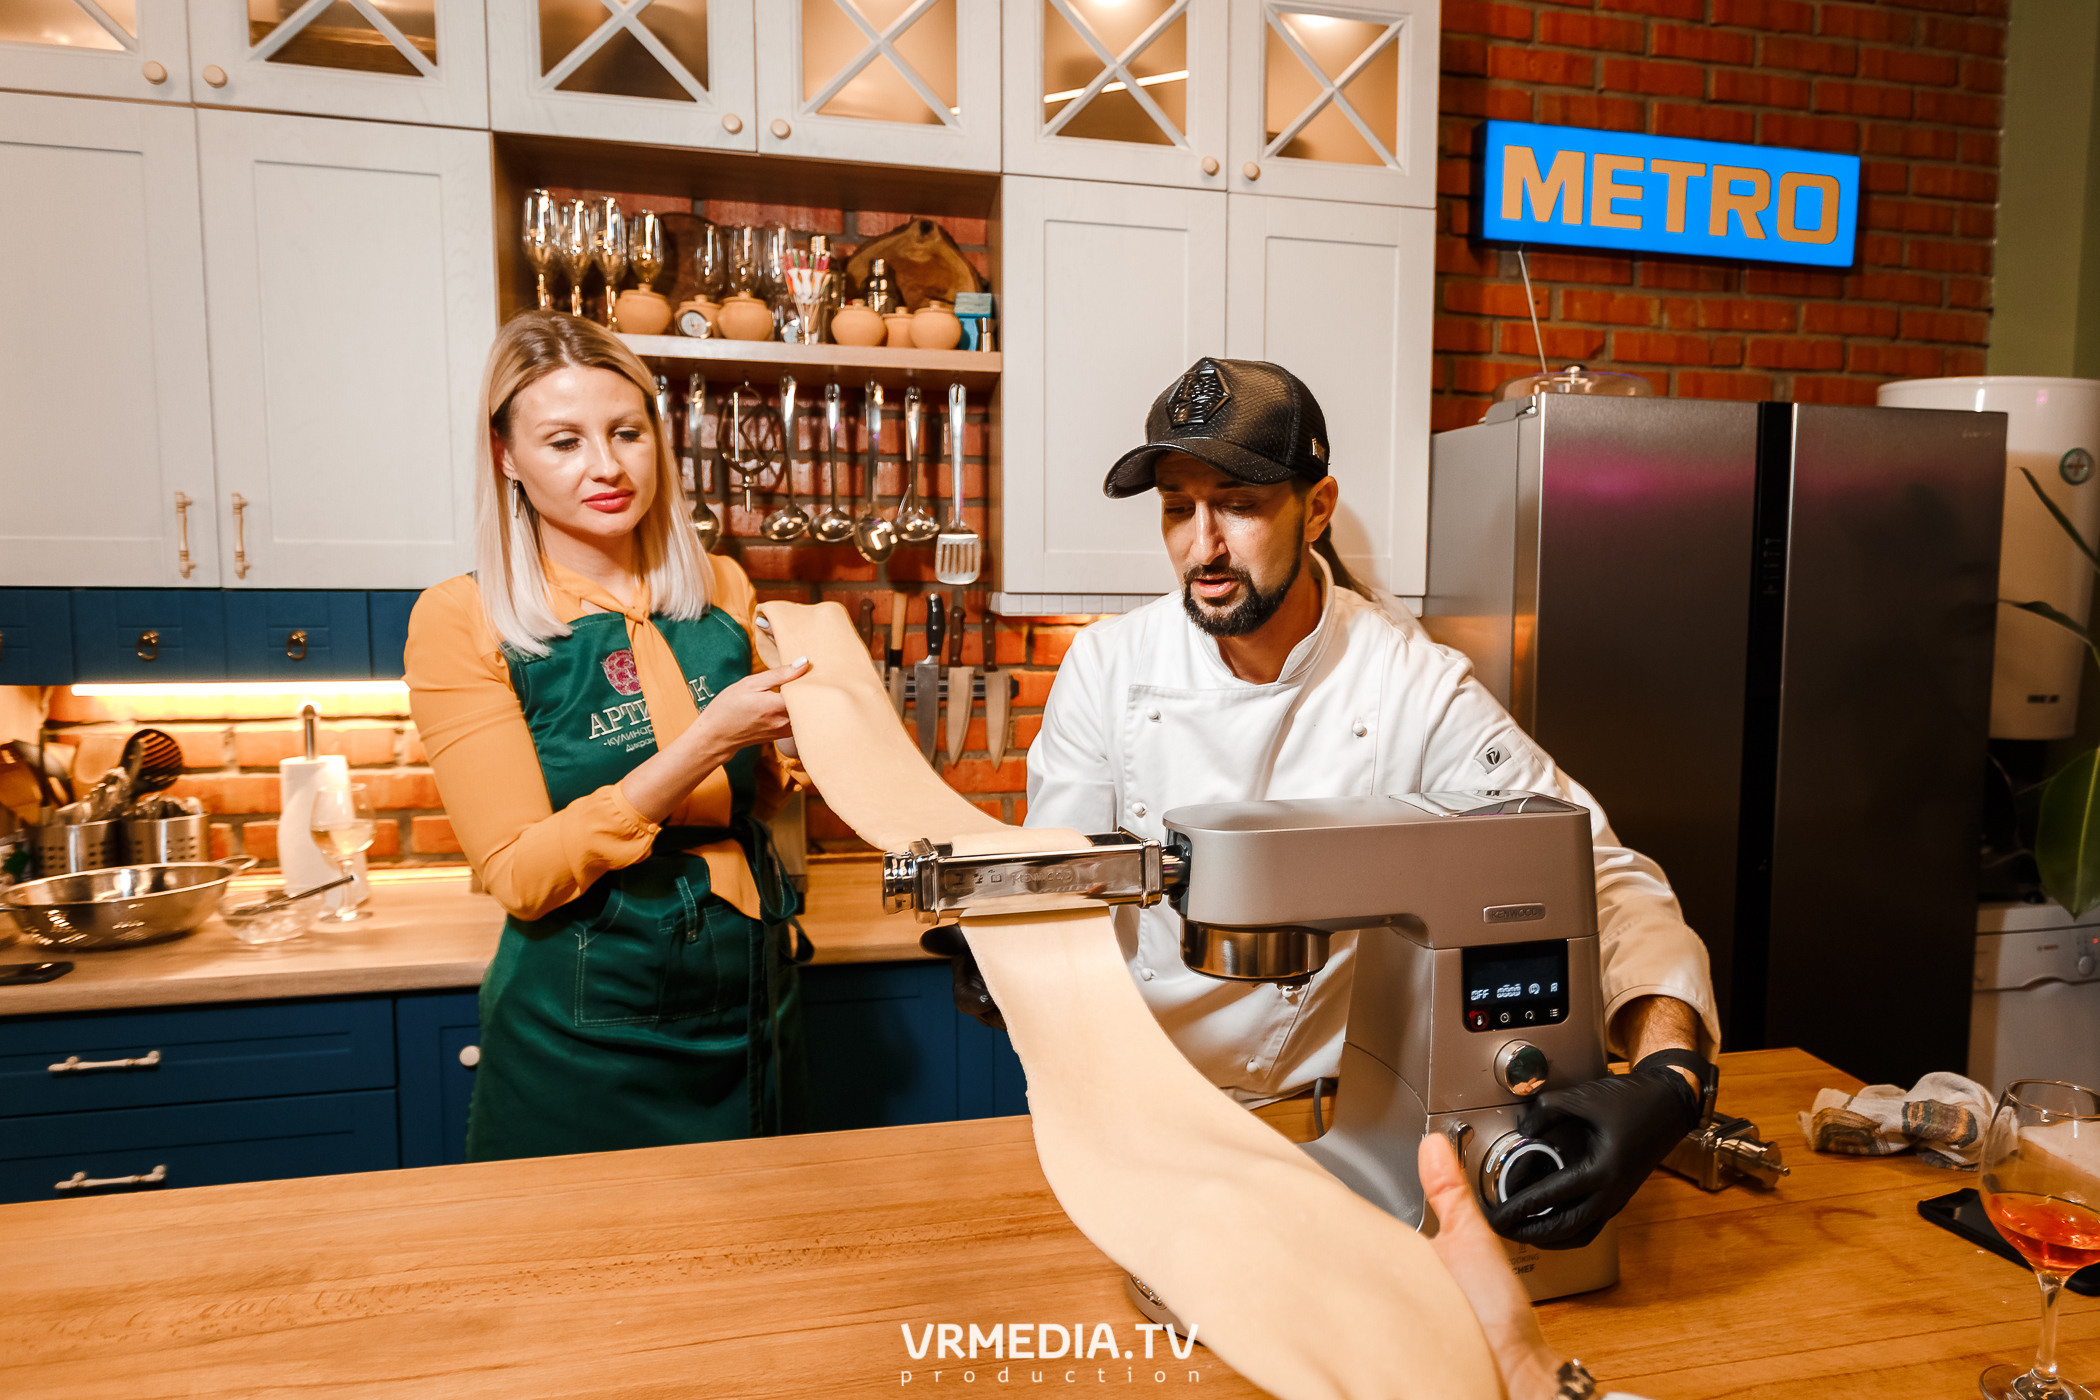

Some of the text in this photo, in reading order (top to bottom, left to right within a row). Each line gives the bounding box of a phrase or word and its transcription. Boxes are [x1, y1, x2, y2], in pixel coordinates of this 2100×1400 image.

[1502, 145, 1840, 245] METRO
[589, 675, 715, 740] АРТИК
[1491, 908, 1537, 919] KENWOOD
[1470, 989, 1489, 1001] OFF
